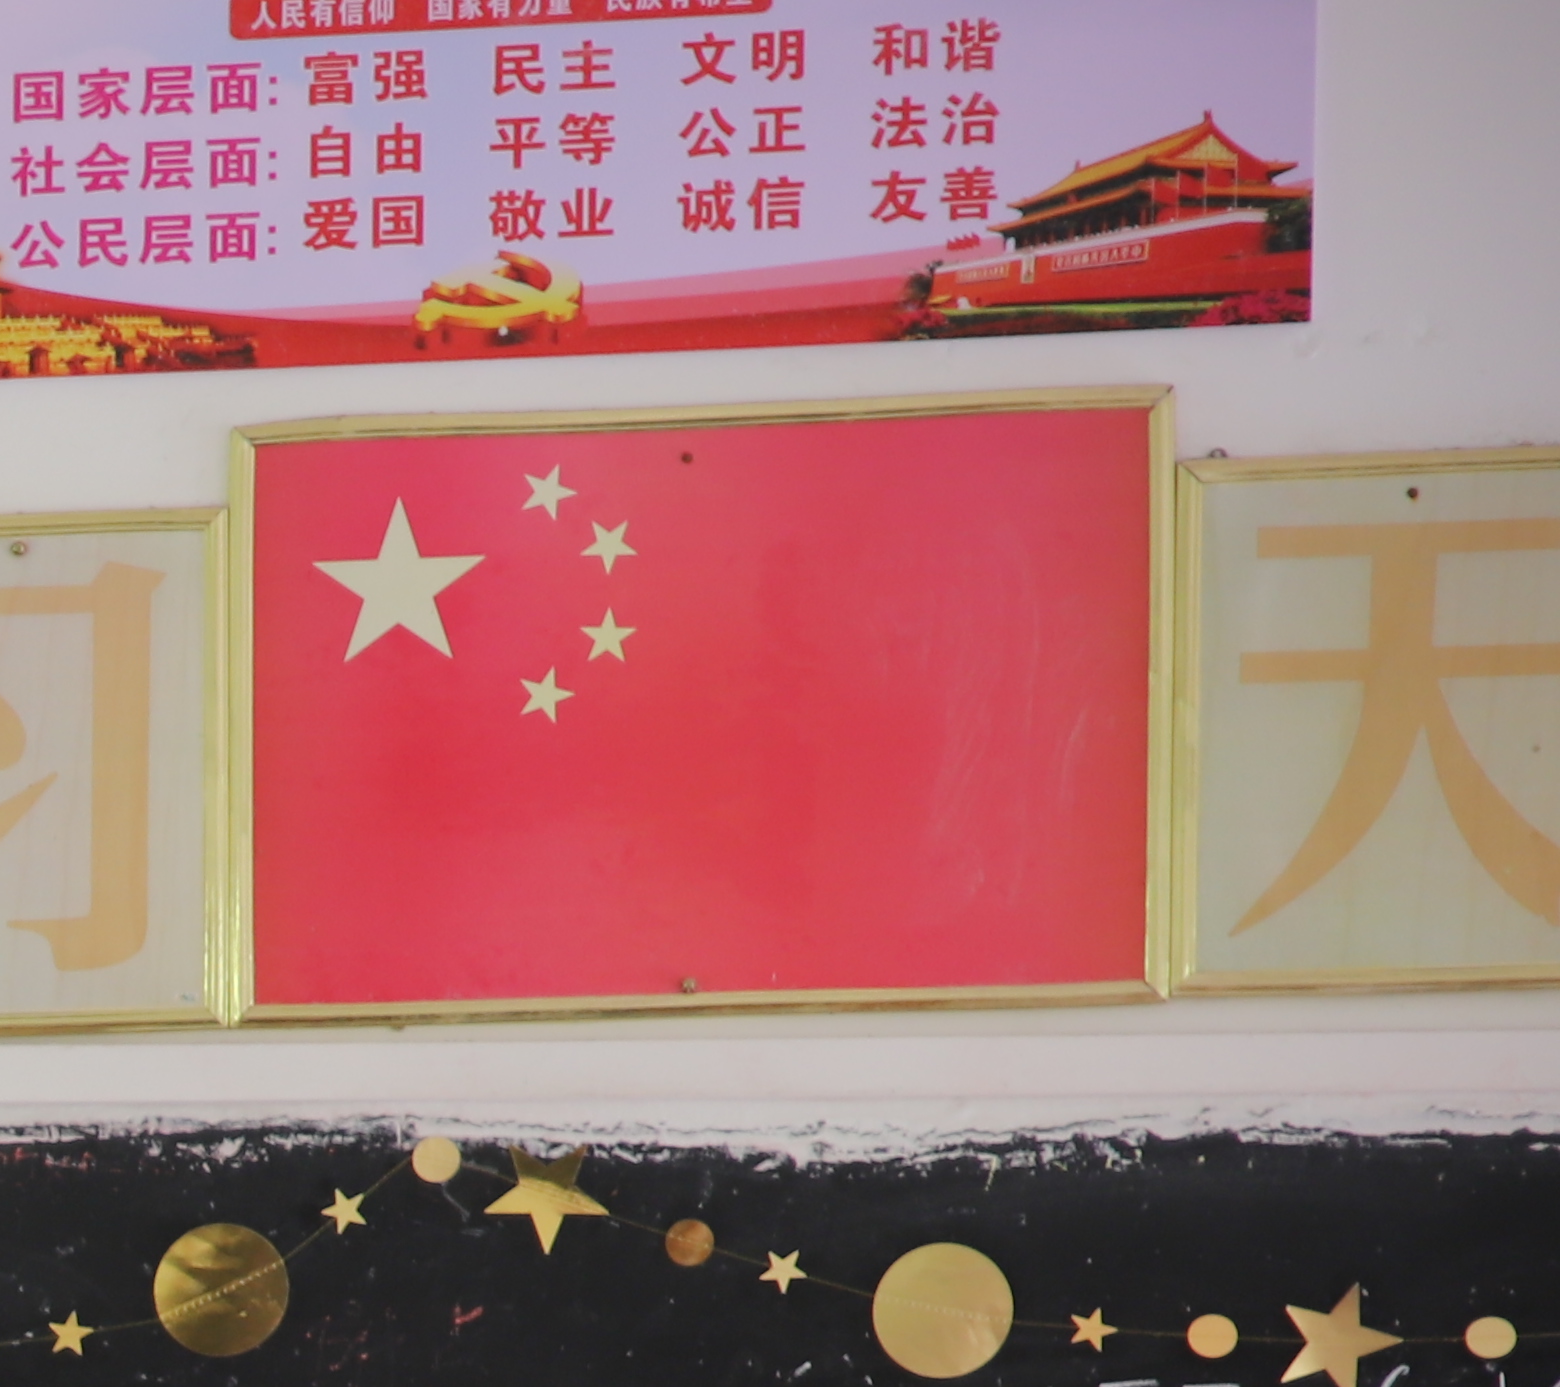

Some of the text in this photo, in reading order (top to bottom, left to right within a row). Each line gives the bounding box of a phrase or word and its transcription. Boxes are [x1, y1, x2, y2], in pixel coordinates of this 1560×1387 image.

[251, 0, 395, 30] 人民有信仰
[493, 40, 616, 96] 民主
[681, 29, 805, 85] 文明
[873, 18, 1000, 76] 和谐
[490, 112, 615, 169] 平等
[679, 105, 805, 158] 公正
[871, 93, 999, 149] 法治
[490, 188, 614, 241] 敬业
[678, 176, 804, 232] 诚信
[871, 166, 997, 222] 友善
[1229, 518, 1560, 939] 天
